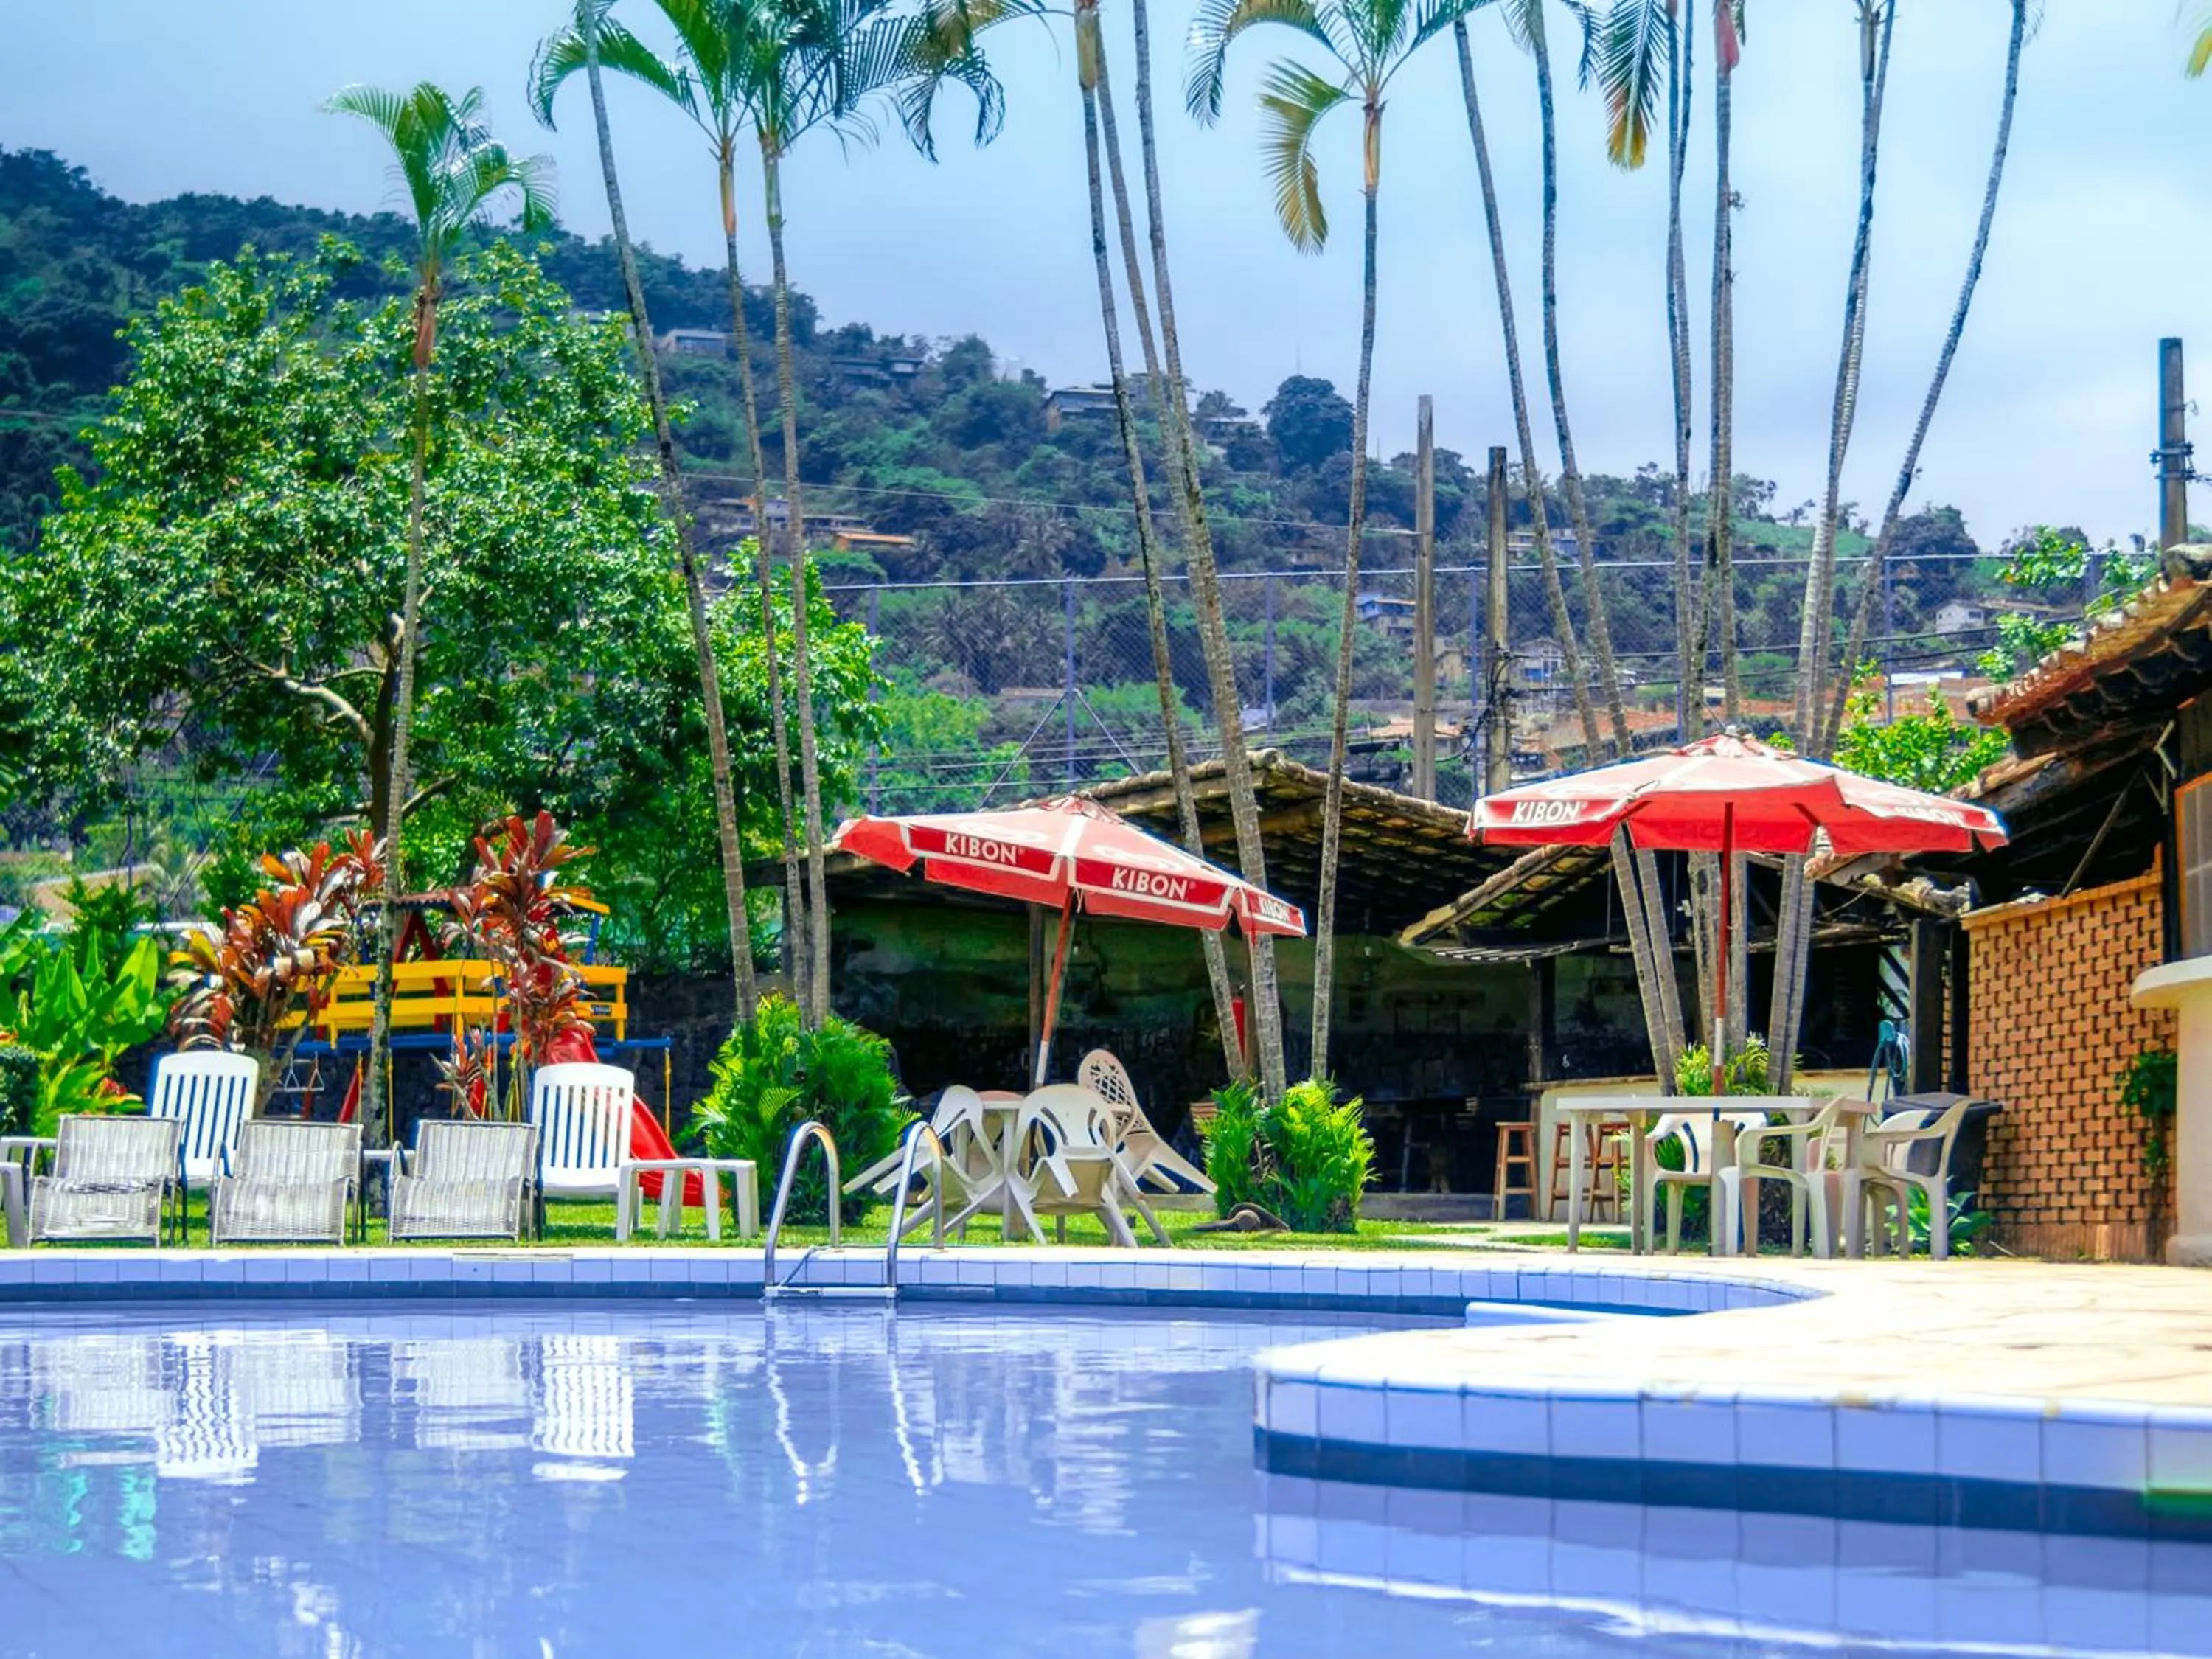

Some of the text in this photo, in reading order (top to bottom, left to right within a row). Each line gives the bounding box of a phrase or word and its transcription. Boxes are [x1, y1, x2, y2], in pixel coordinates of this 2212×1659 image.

[1511, 801, 1581, 823] KIBON
[945, 832, 1016, 864] KIBON
[1112, 867, 1188, 900] KIBON
